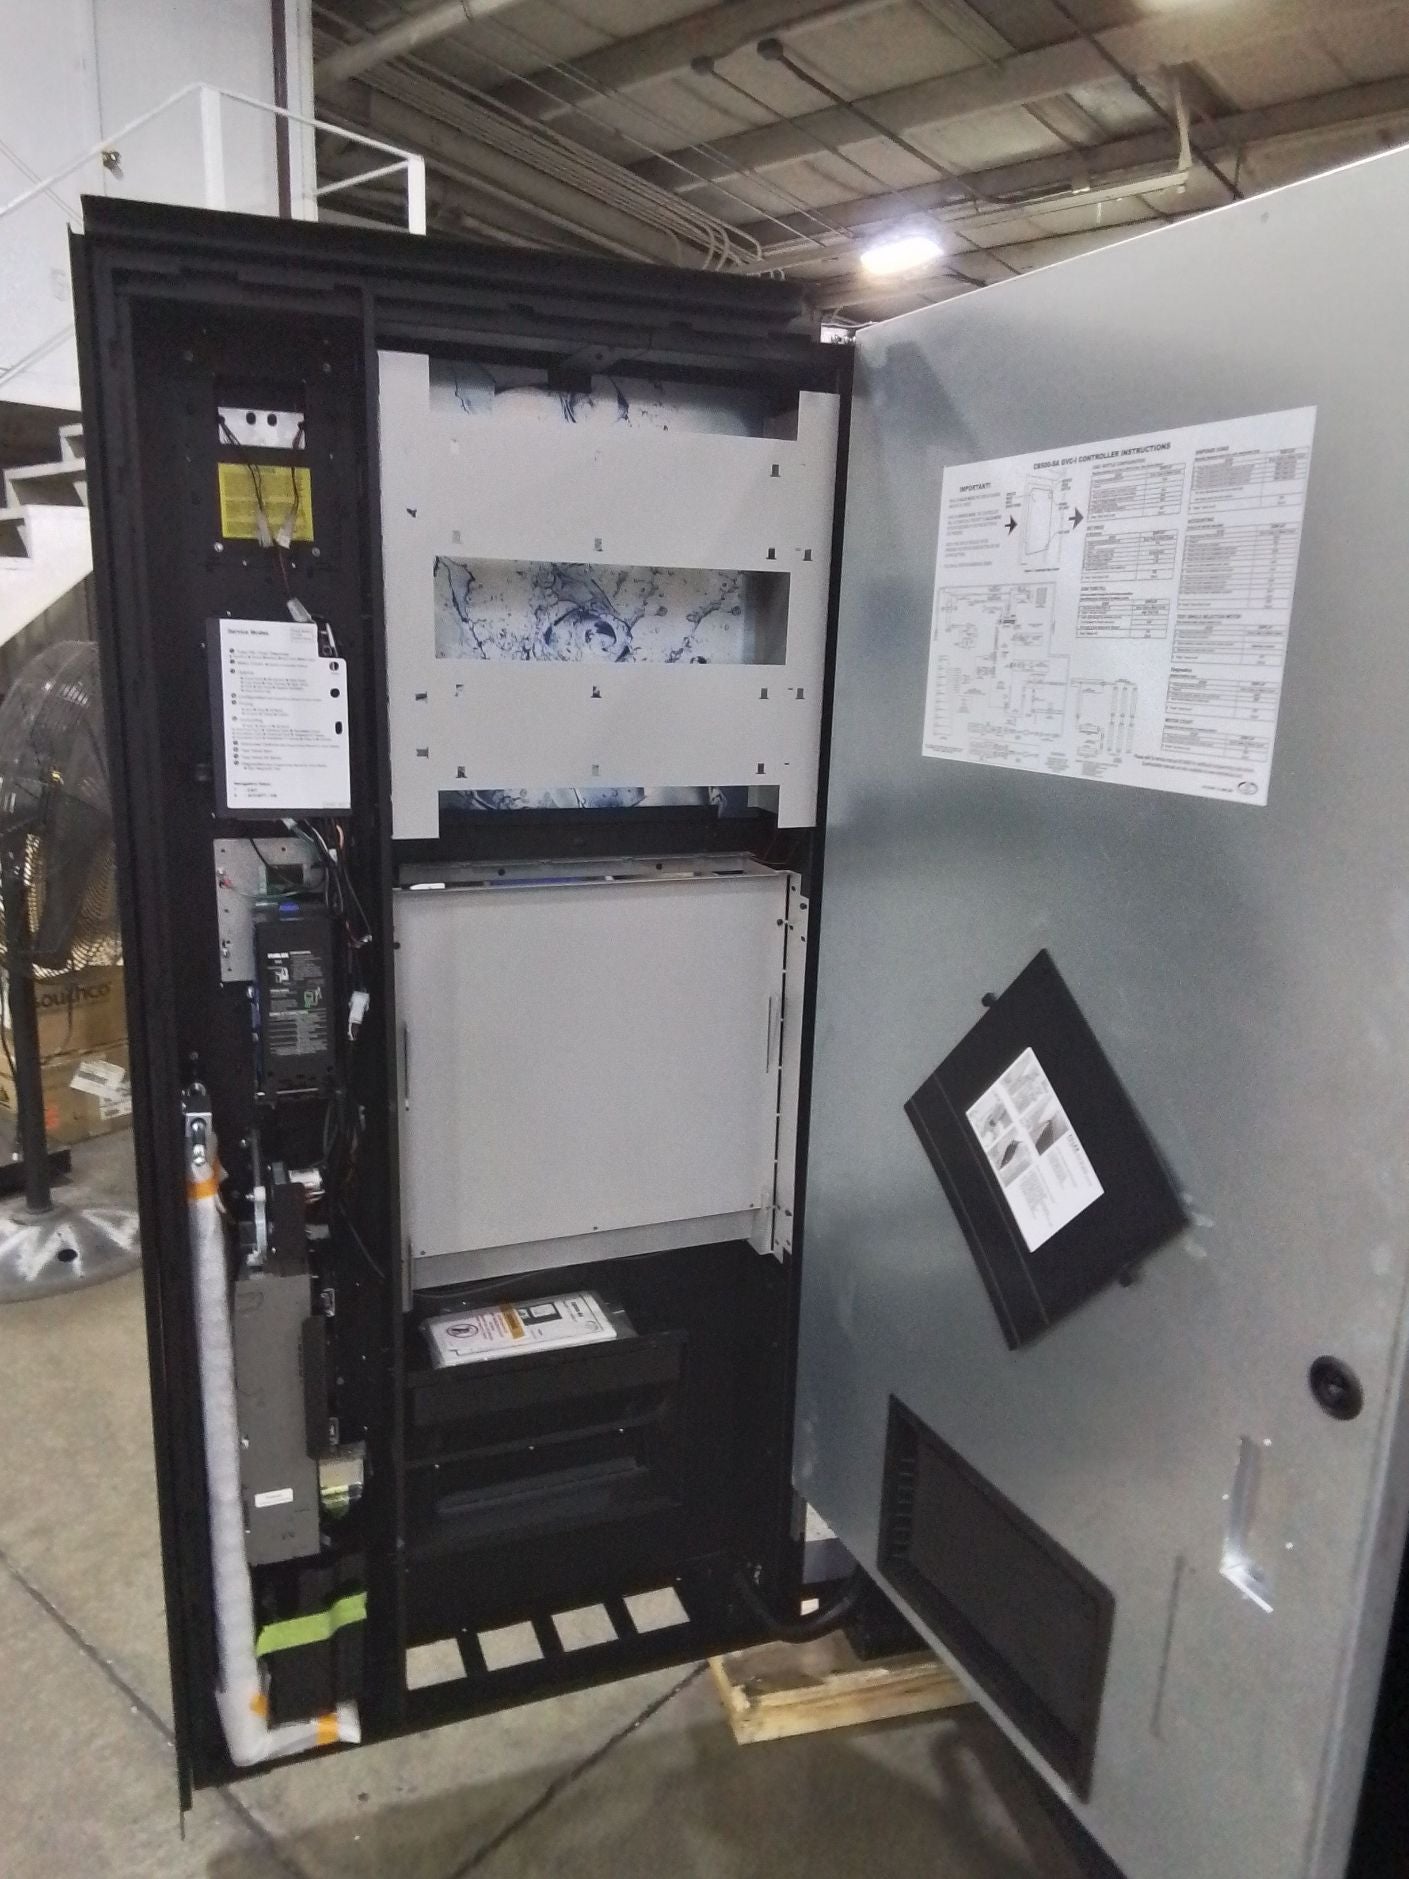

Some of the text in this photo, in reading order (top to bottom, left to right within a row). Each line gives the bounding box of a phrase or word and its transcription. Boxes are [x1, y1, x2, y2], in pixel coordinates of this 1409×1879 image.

[1079, 451, 1119, 463] CONTROLLER
[1121, 442, 1171, 456] INSTRUCTIONS
[33, 983, 112, 1008] outhco
